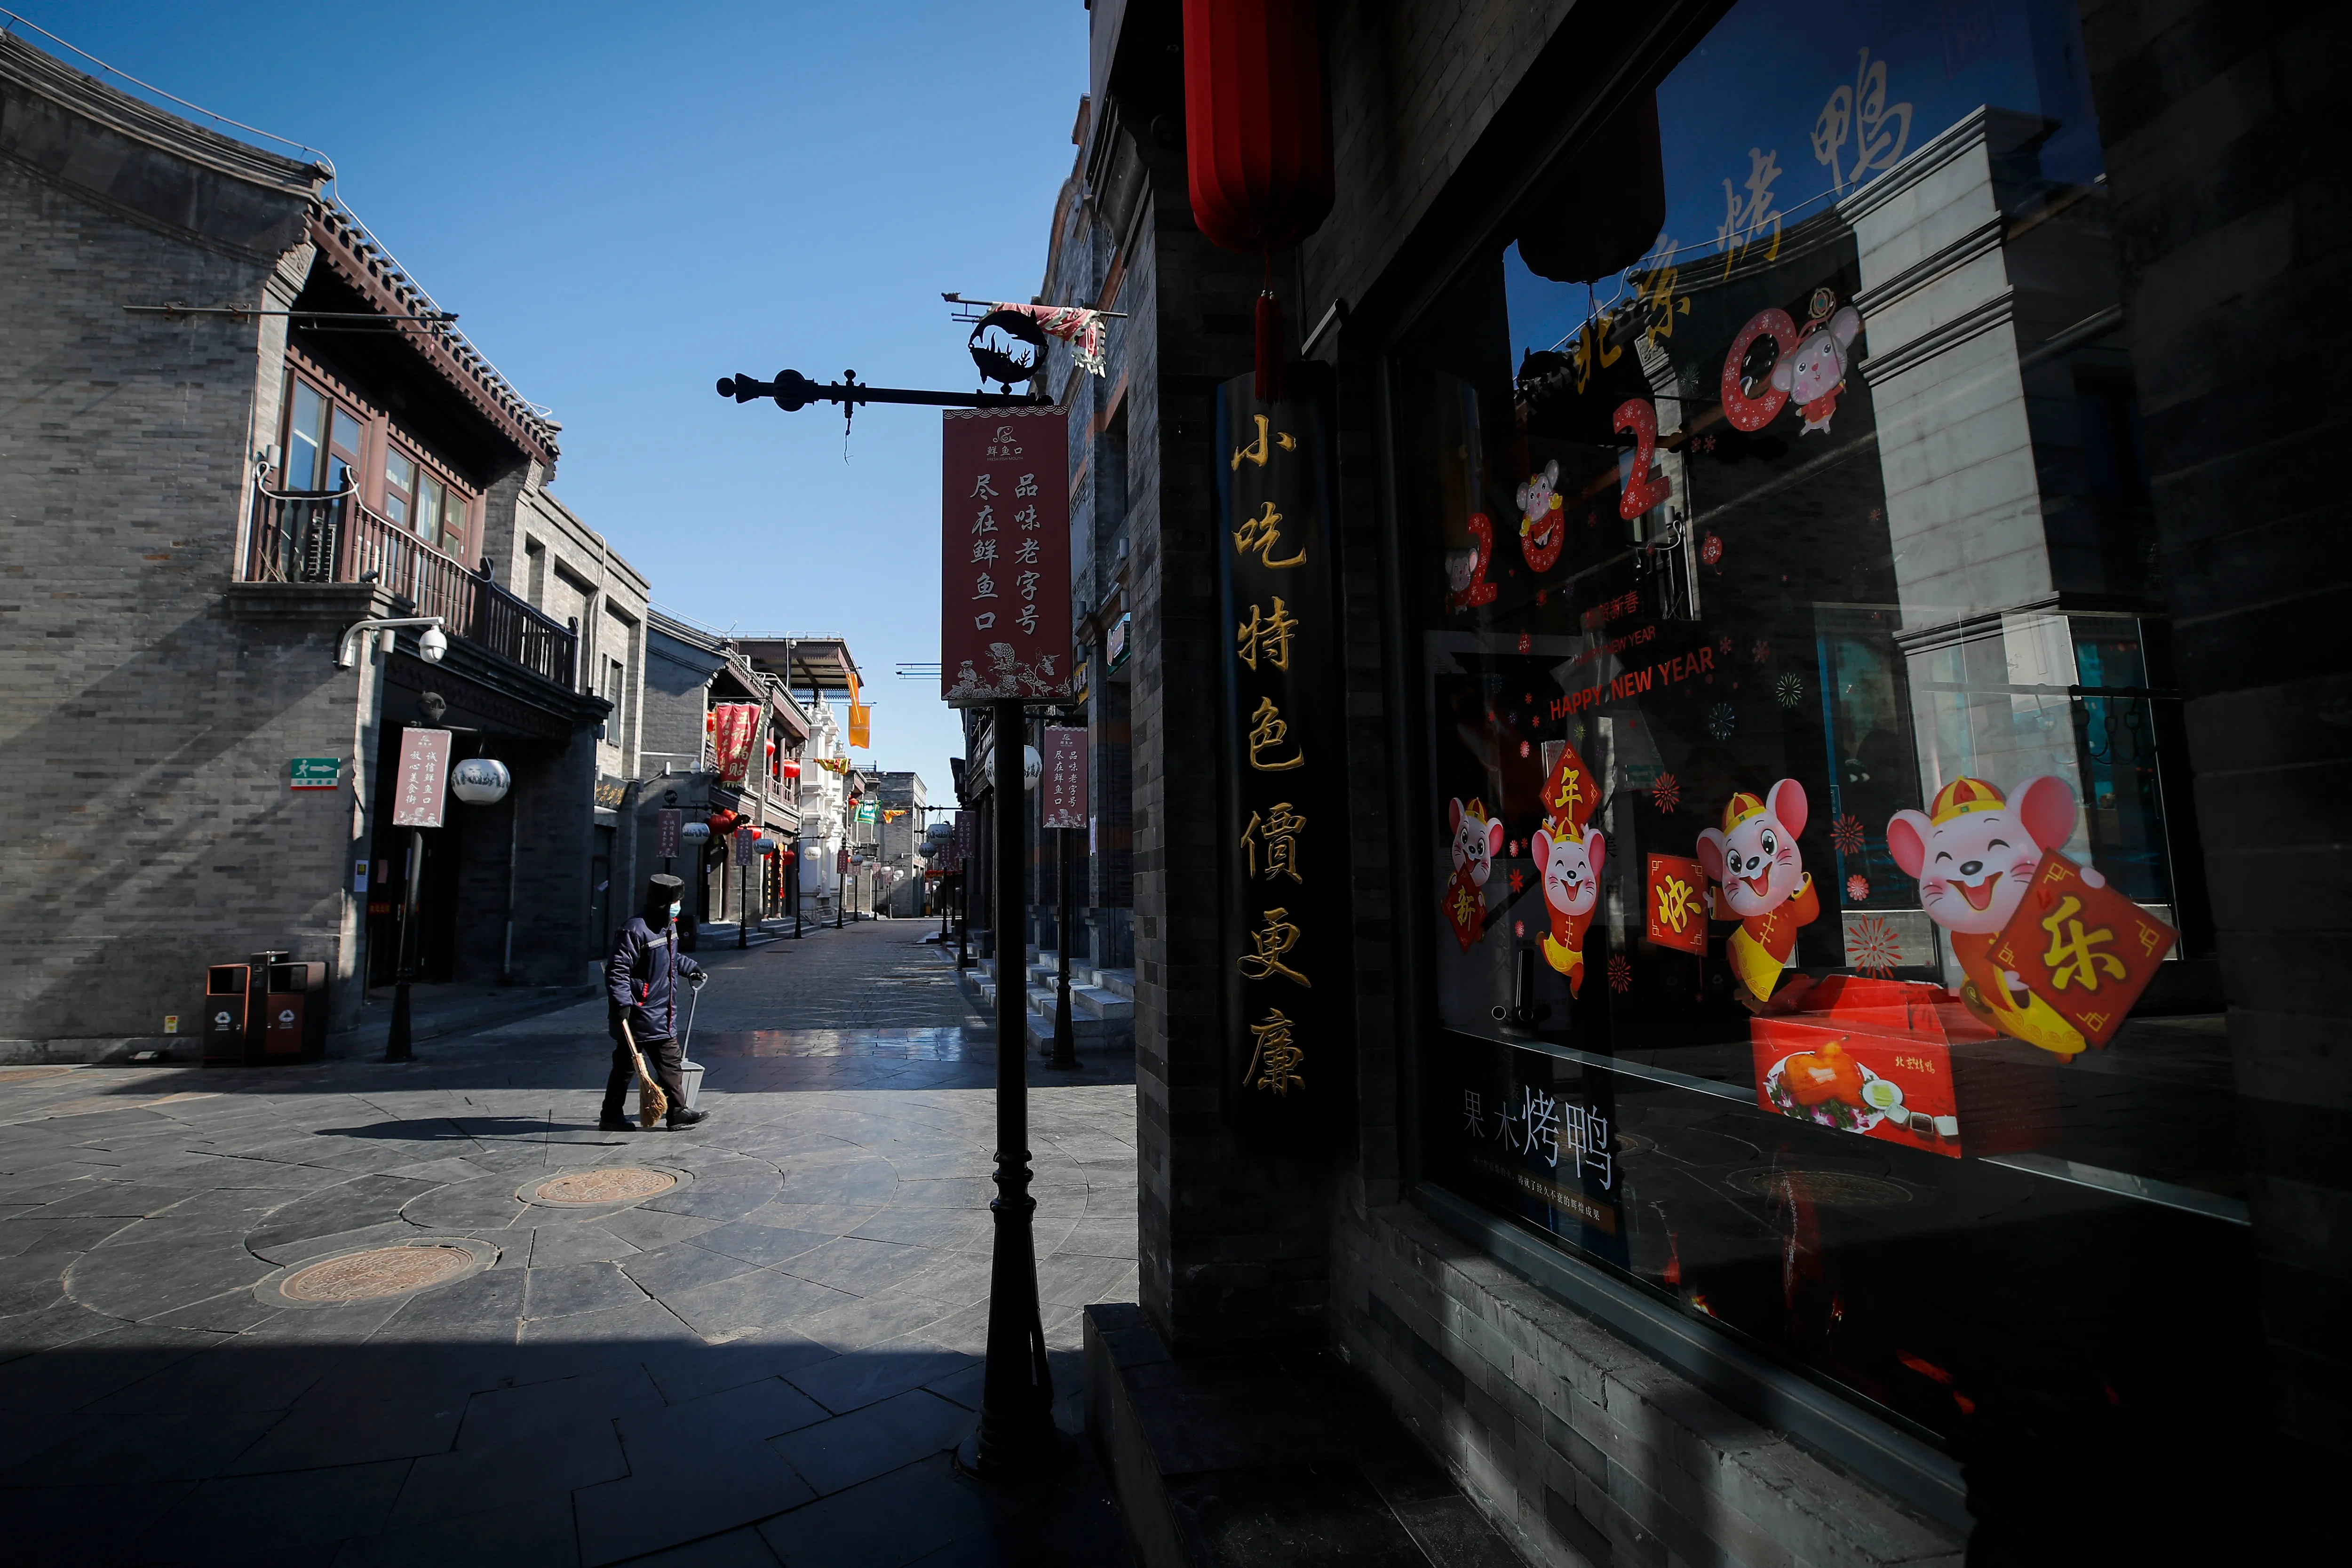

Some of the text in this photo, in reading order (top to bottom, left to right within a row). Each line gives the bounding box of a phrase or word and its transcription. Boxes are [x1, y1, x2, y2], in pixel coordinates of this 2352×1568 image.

[1573, 47, 1913, 394] 北京烤鸭
[986, 446, 1023, 457] 鲜鱼口
[969, 473, 999, 630] 尽在鲜鱼口
[1015, 473, 1041, 635] 品味老字号
[1605, 635, 1627, 655] NEW
[1628, 625, 1657, 647] YEAR
[1550, 646, 1715, 721] HAPPY NEW YEAR
[728, 712, 751, 777] 王记锅贴
[1231, 414, 1311, 1098] 小吃特色價更廉
[405, 751, 421, 804] 放心美食街
[422, 751, 437, 804] 诚信鲜鱼口
[1054, 750, 1064, 805] 尽在鲜鱼口
[1068, 751, 1078, 807] 品味老字号
[1555, 767, 1583, 820] 年
[1454, 885, 1476, 932] 新
[1656, 875, 1701, 933] 快
[2042, 896, 2127, 991] 乐
[1895, 1056, 1935, 1074] 北京烤鸭
[1463, 1085, 1612, 1190] 果木烤鸭
